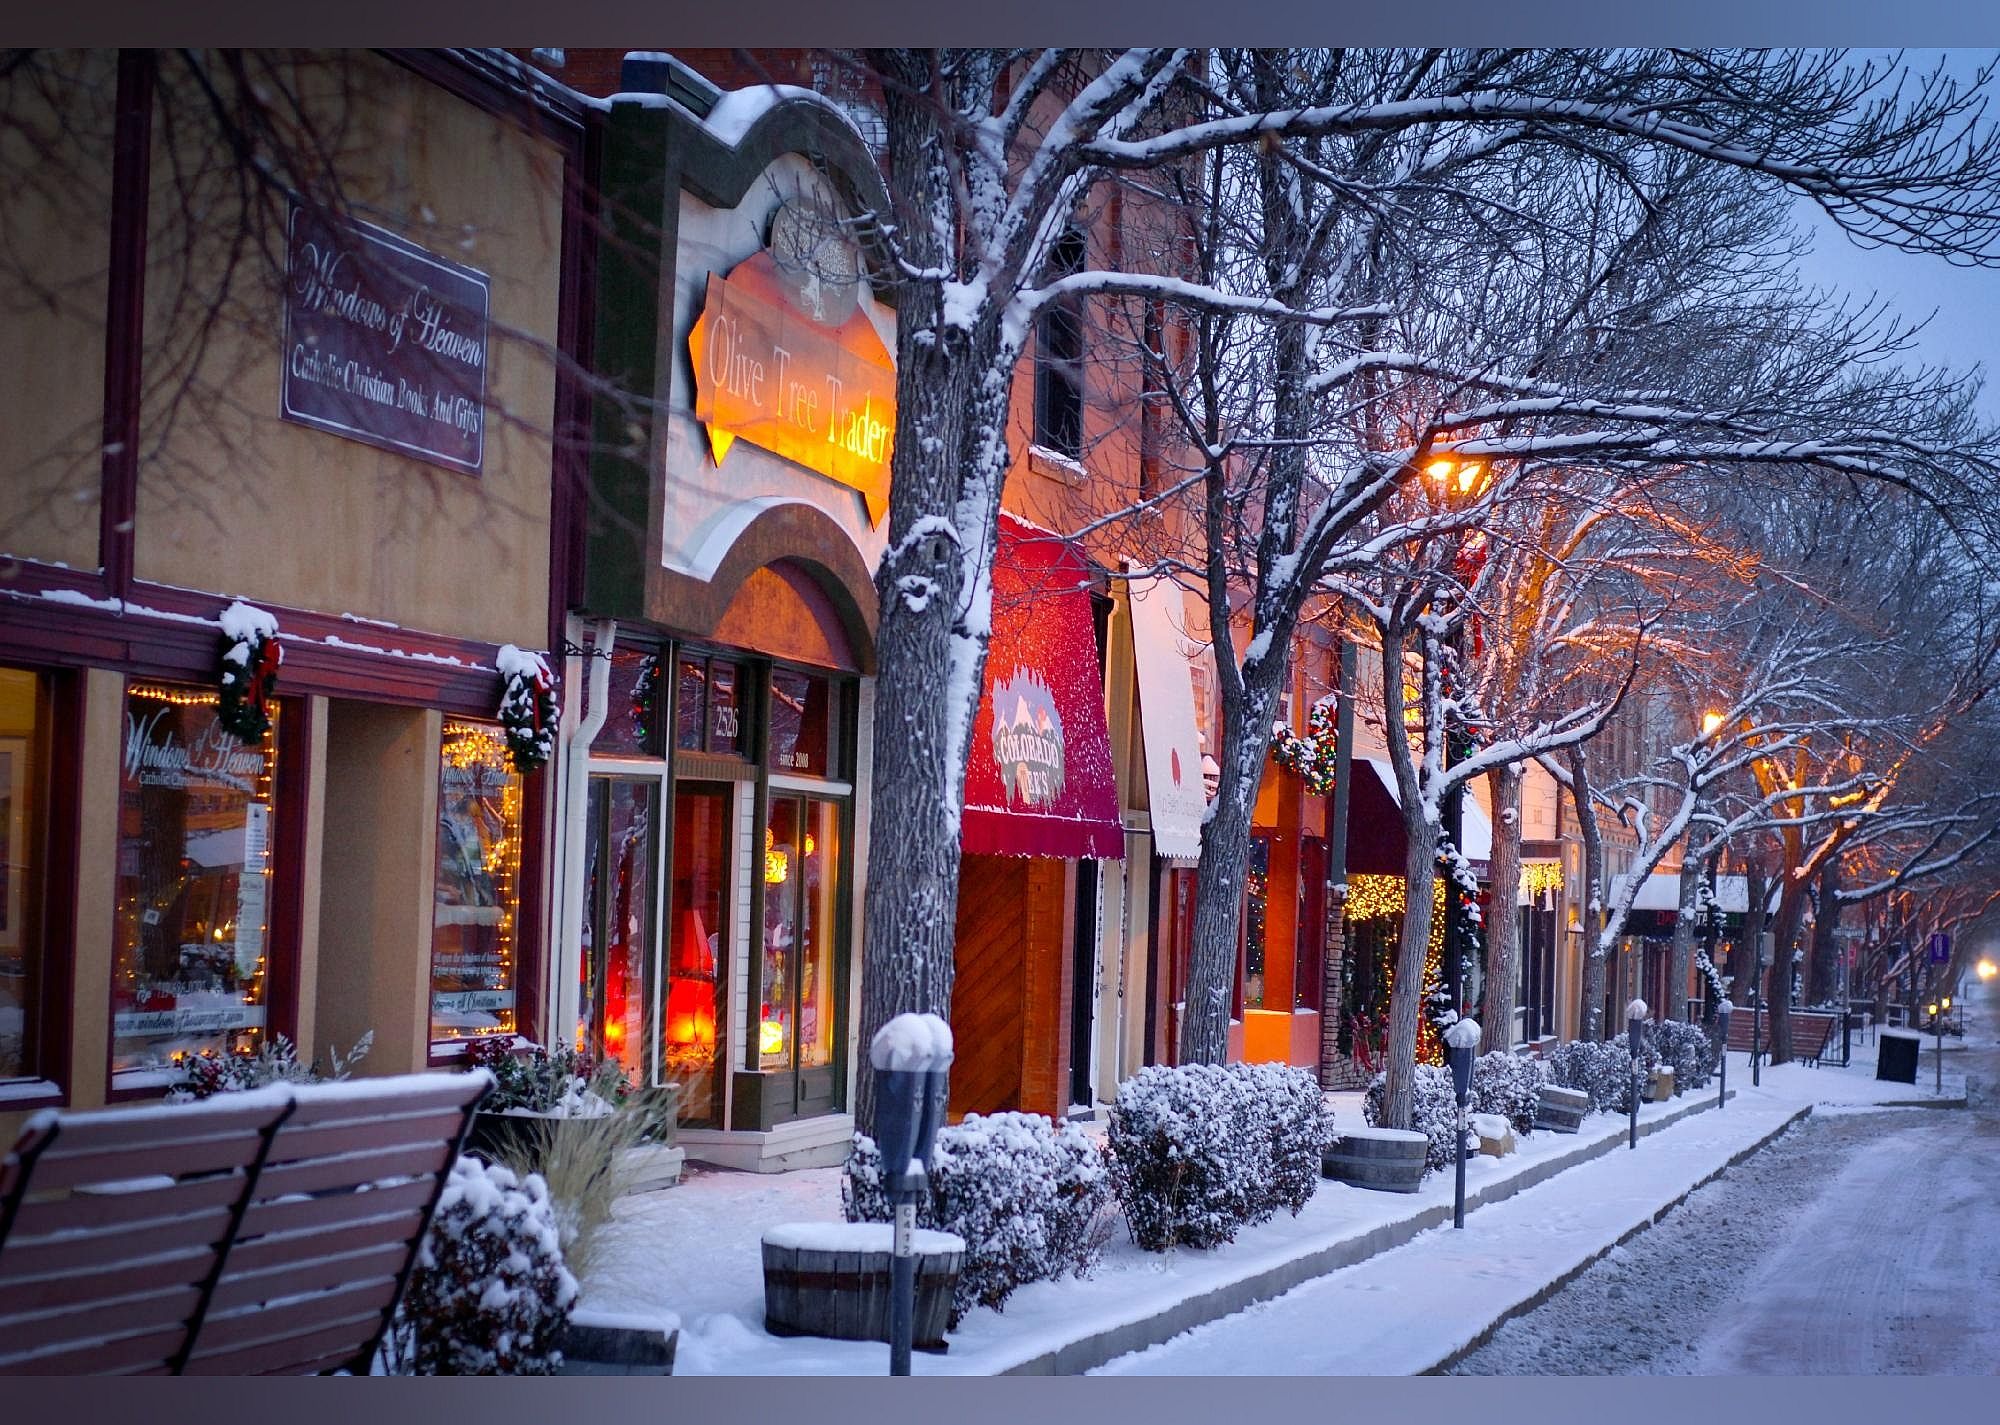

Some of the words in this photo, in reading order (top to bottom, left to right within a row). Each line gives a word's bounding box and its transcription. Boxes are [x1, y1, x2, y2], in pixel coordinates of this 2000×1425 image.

[294, 243, 386, 332] Windows
[387, 294, 414, 354] of
[411, 284, 482, 367] Heaven
[292, 343, 342, 390] Catholic
[343, 360, 394, 406] Christian
[397, 377, 428, 417] Books
[430, 390, 453, 425] And
[455, 397, 480, 439] Gifts
[709, 315, 764, 408] Olive
[773, 346, 818, 433] Tree
[125, 707, 191, 781] Windows
[204, 715, 264, 775] Heaven
[715, 705, 739, 738] 2526
[1000, 732, 1059, 769] COLORADO
